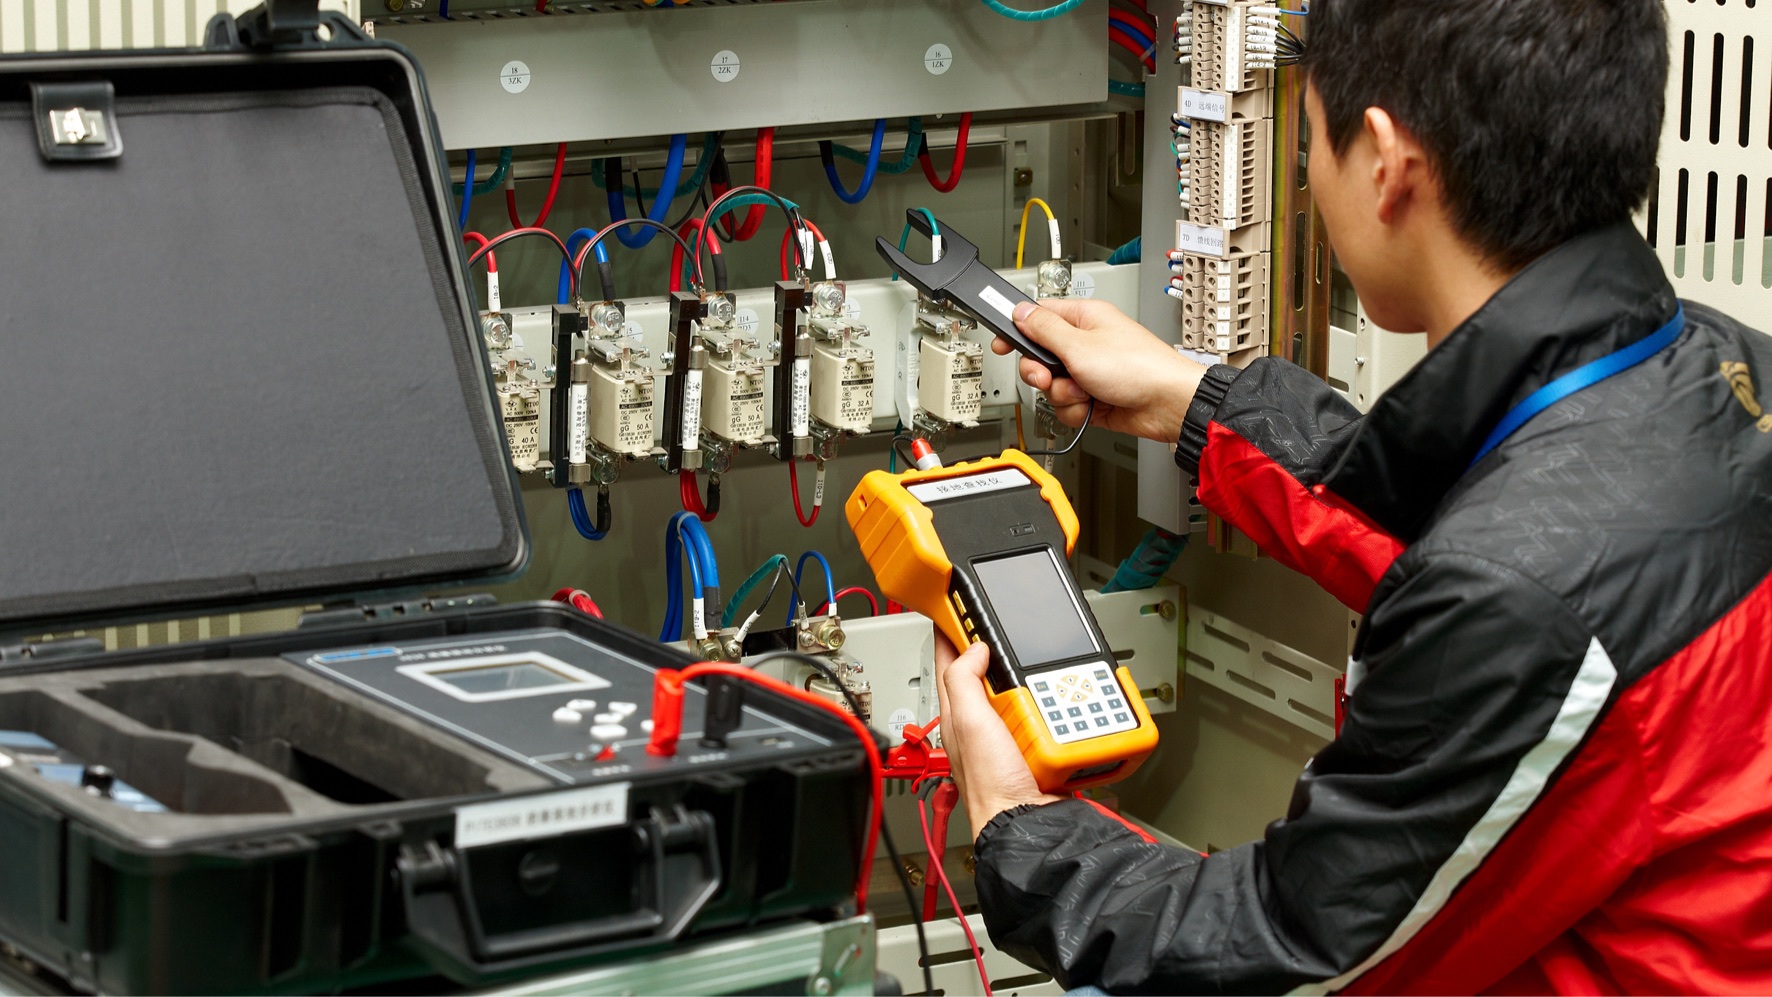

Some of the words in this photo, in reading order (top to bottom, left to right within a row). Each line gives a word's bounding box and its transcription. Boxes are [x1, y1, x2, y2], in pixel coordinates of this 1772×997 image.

[1182, 234, 1190, 242] 7D
[936, 477, 1002, 493] 接地查找仪
